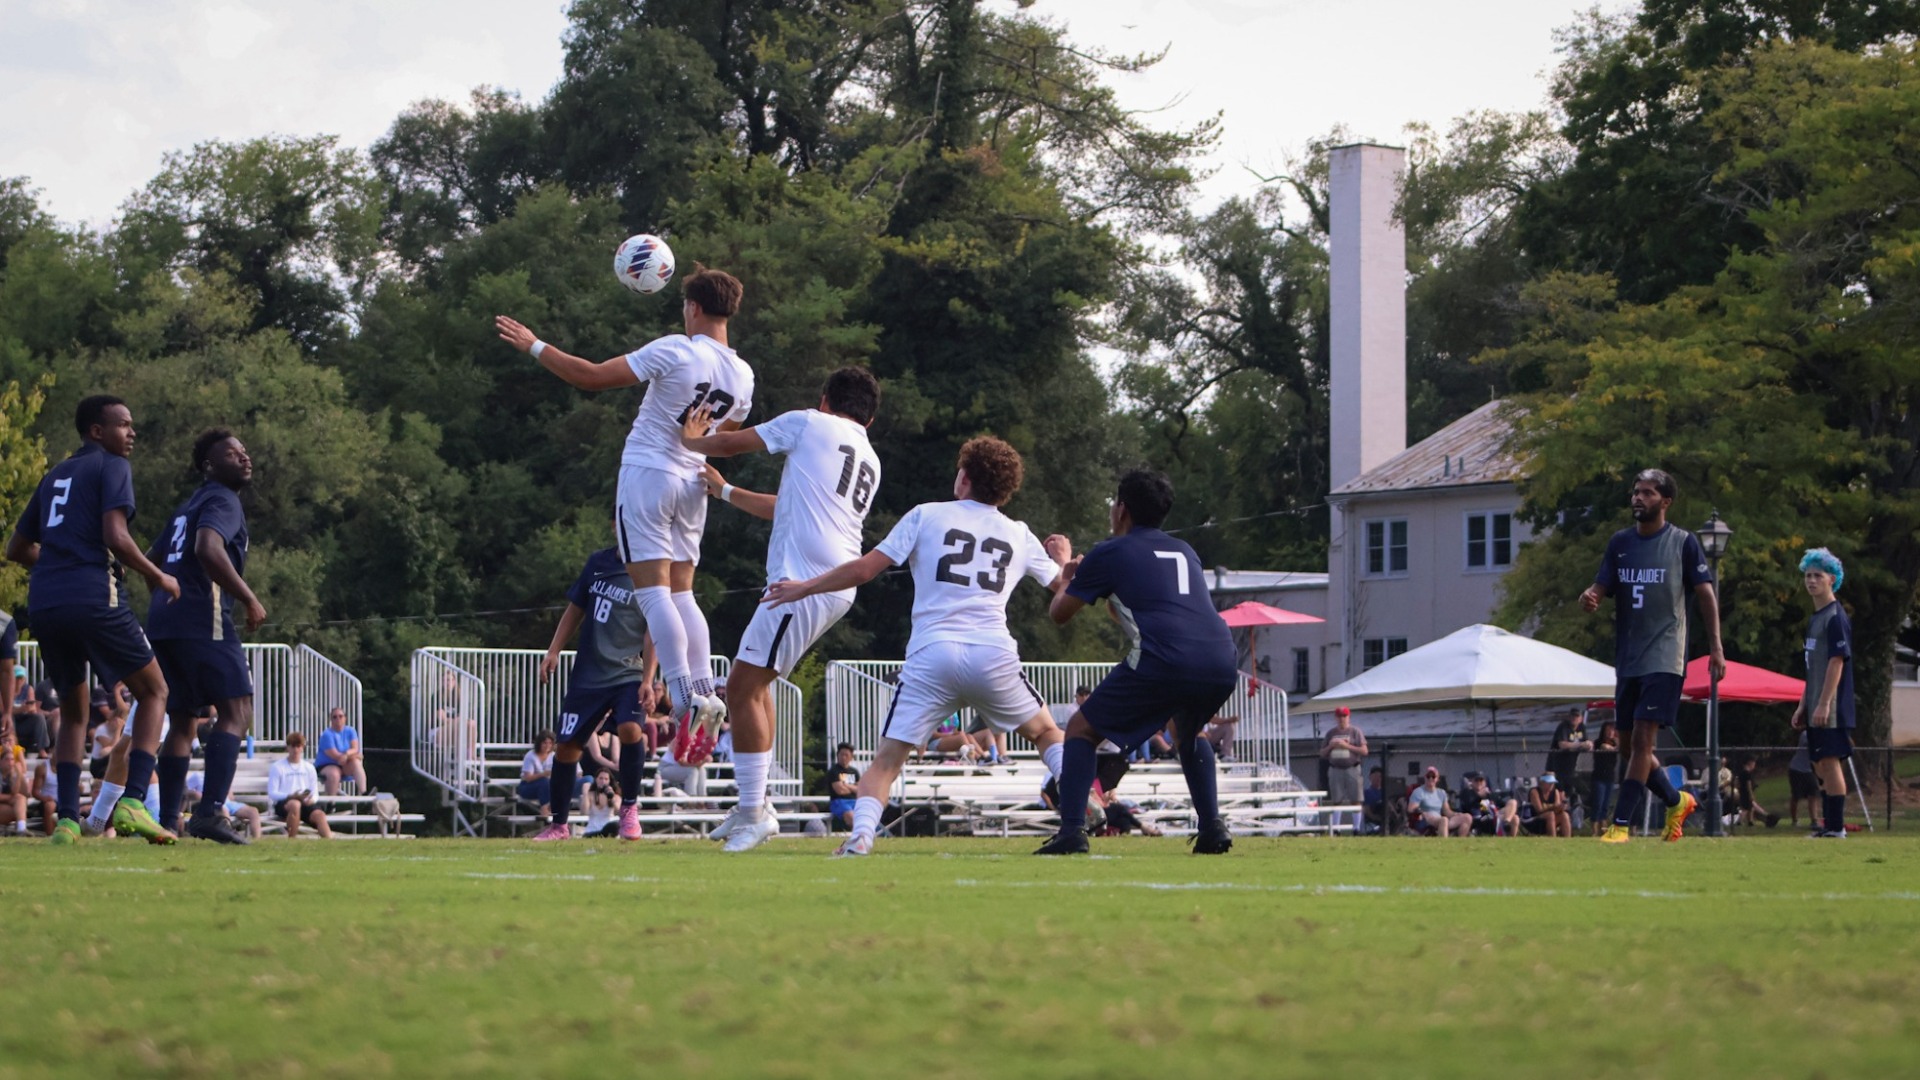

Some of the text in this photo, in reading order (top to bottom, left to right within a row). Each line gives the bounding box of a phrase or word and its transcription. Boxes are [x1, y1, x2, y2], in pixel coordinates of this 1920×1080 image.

[836, 444, 876, 514] 16
[47, 477, 72, 527] 2
[936, 528, 1014, 594] 23
[1153, 550, 1190, 595] 7
[593, 596, 613, 624] 18
[1632, 585, 1644, 609] 5
[560, 712, 579, 735] 18
